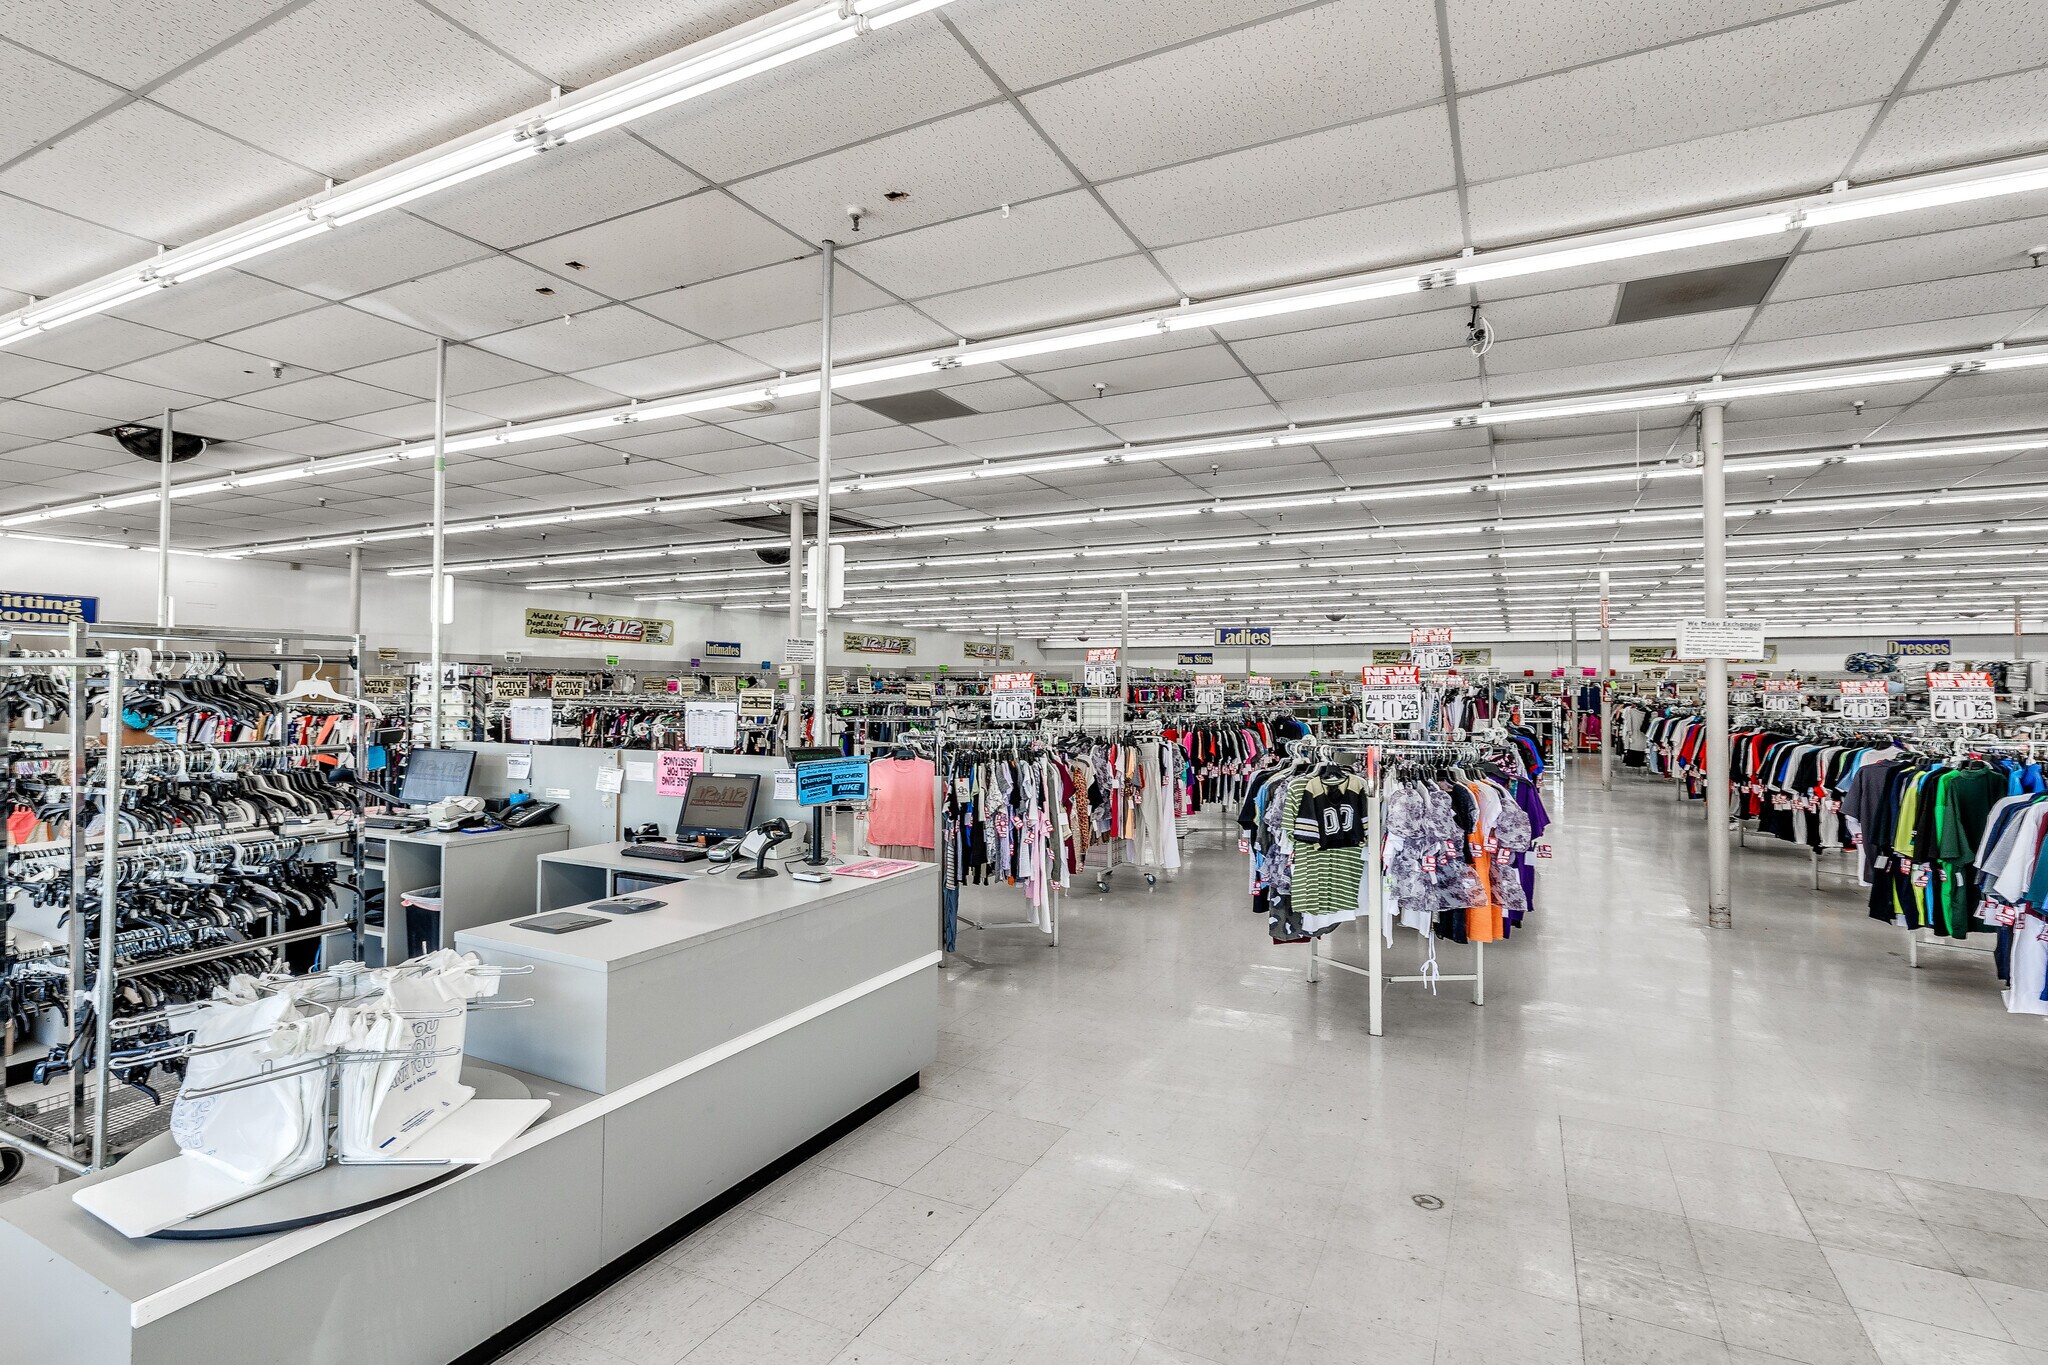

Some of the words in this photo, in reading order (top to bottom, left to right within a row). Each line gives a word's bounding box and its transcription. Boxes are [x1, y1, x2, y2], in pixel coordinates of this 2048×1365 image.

[0, 594, 83, 613] itting
[0, 609, 84, 622] ooms
[546, 620, 563, 628] Store
[563, 615, 599, 632] 1/2
[610, 618, 643, 636] 1/2
[1215, 629, 1270, 645] Ladies
[707, 643, 740, 656] Intimates
[1888, 641, 1950, 655] Dresses
[1178, 655, 1193, 663] Plus
[1194, 654, 1212, 664] Sizes
[444, 669, 456, 684] 4
[1364, 667, 1417, 675] NEW
[1928, 672, 1986, 680] NEW
[994, 673, 1032, 682] NEW
[1364, 676, 1387, 684] THIS
[1389, 675, 1417, 684] WEEK
[663, 756, 698, 767] ASSISTANCE
[667, 767, 679, 776] FOR
[801, 775, 832, 785] Champion
[412, 1019, 439, 1037] OU
[412, 1035, 437, 1053] OU
